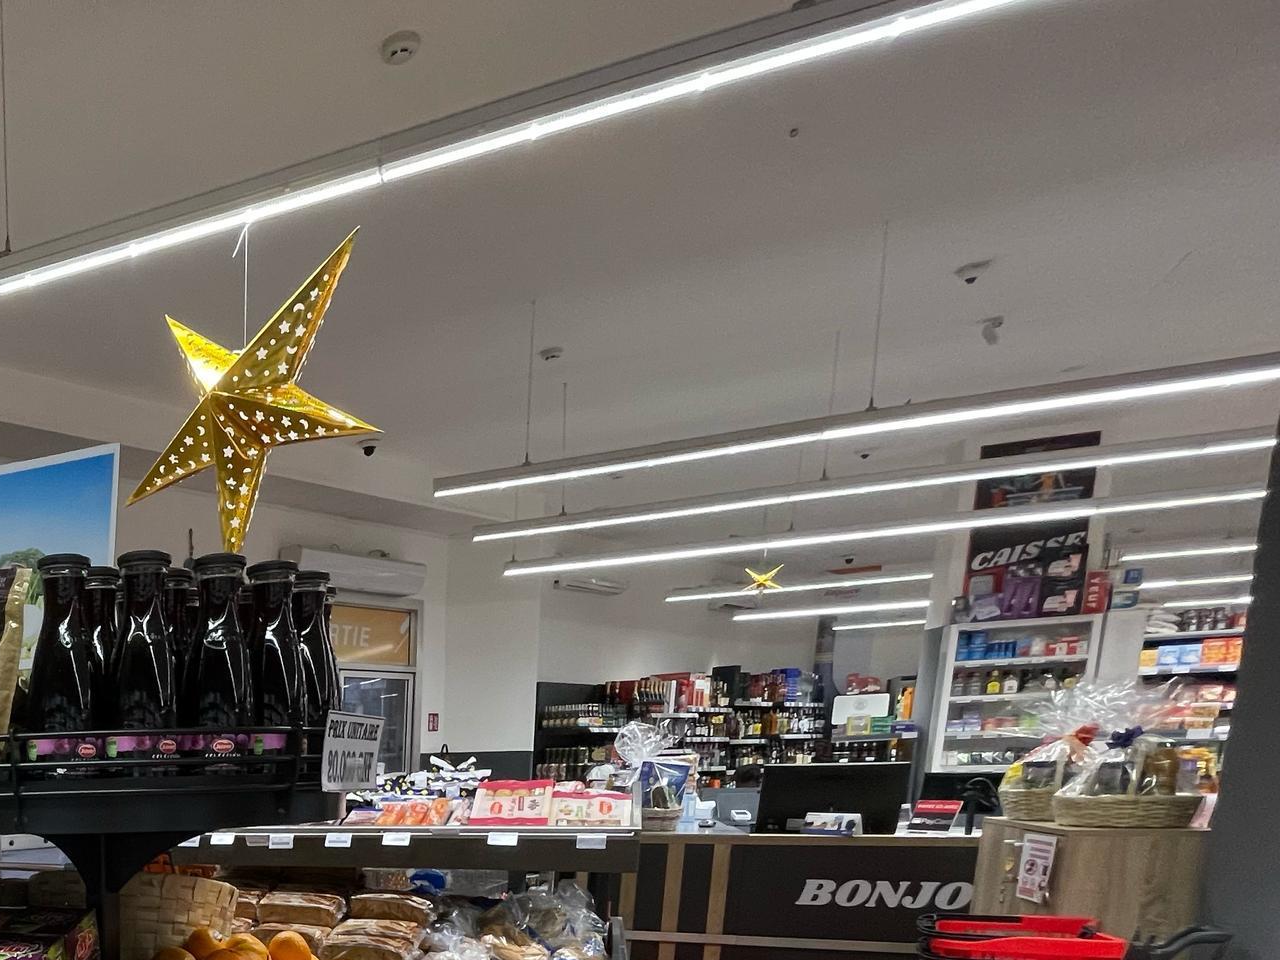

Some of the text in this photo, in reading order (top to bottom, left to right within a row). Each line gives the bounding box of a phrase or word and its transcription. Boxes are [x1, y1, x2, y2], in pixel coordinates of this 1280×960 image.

[330, 624, 371, 647] RTIE
[328, 720, 347, 738] PRIX
[794, 879, 974, 910] BONJO
